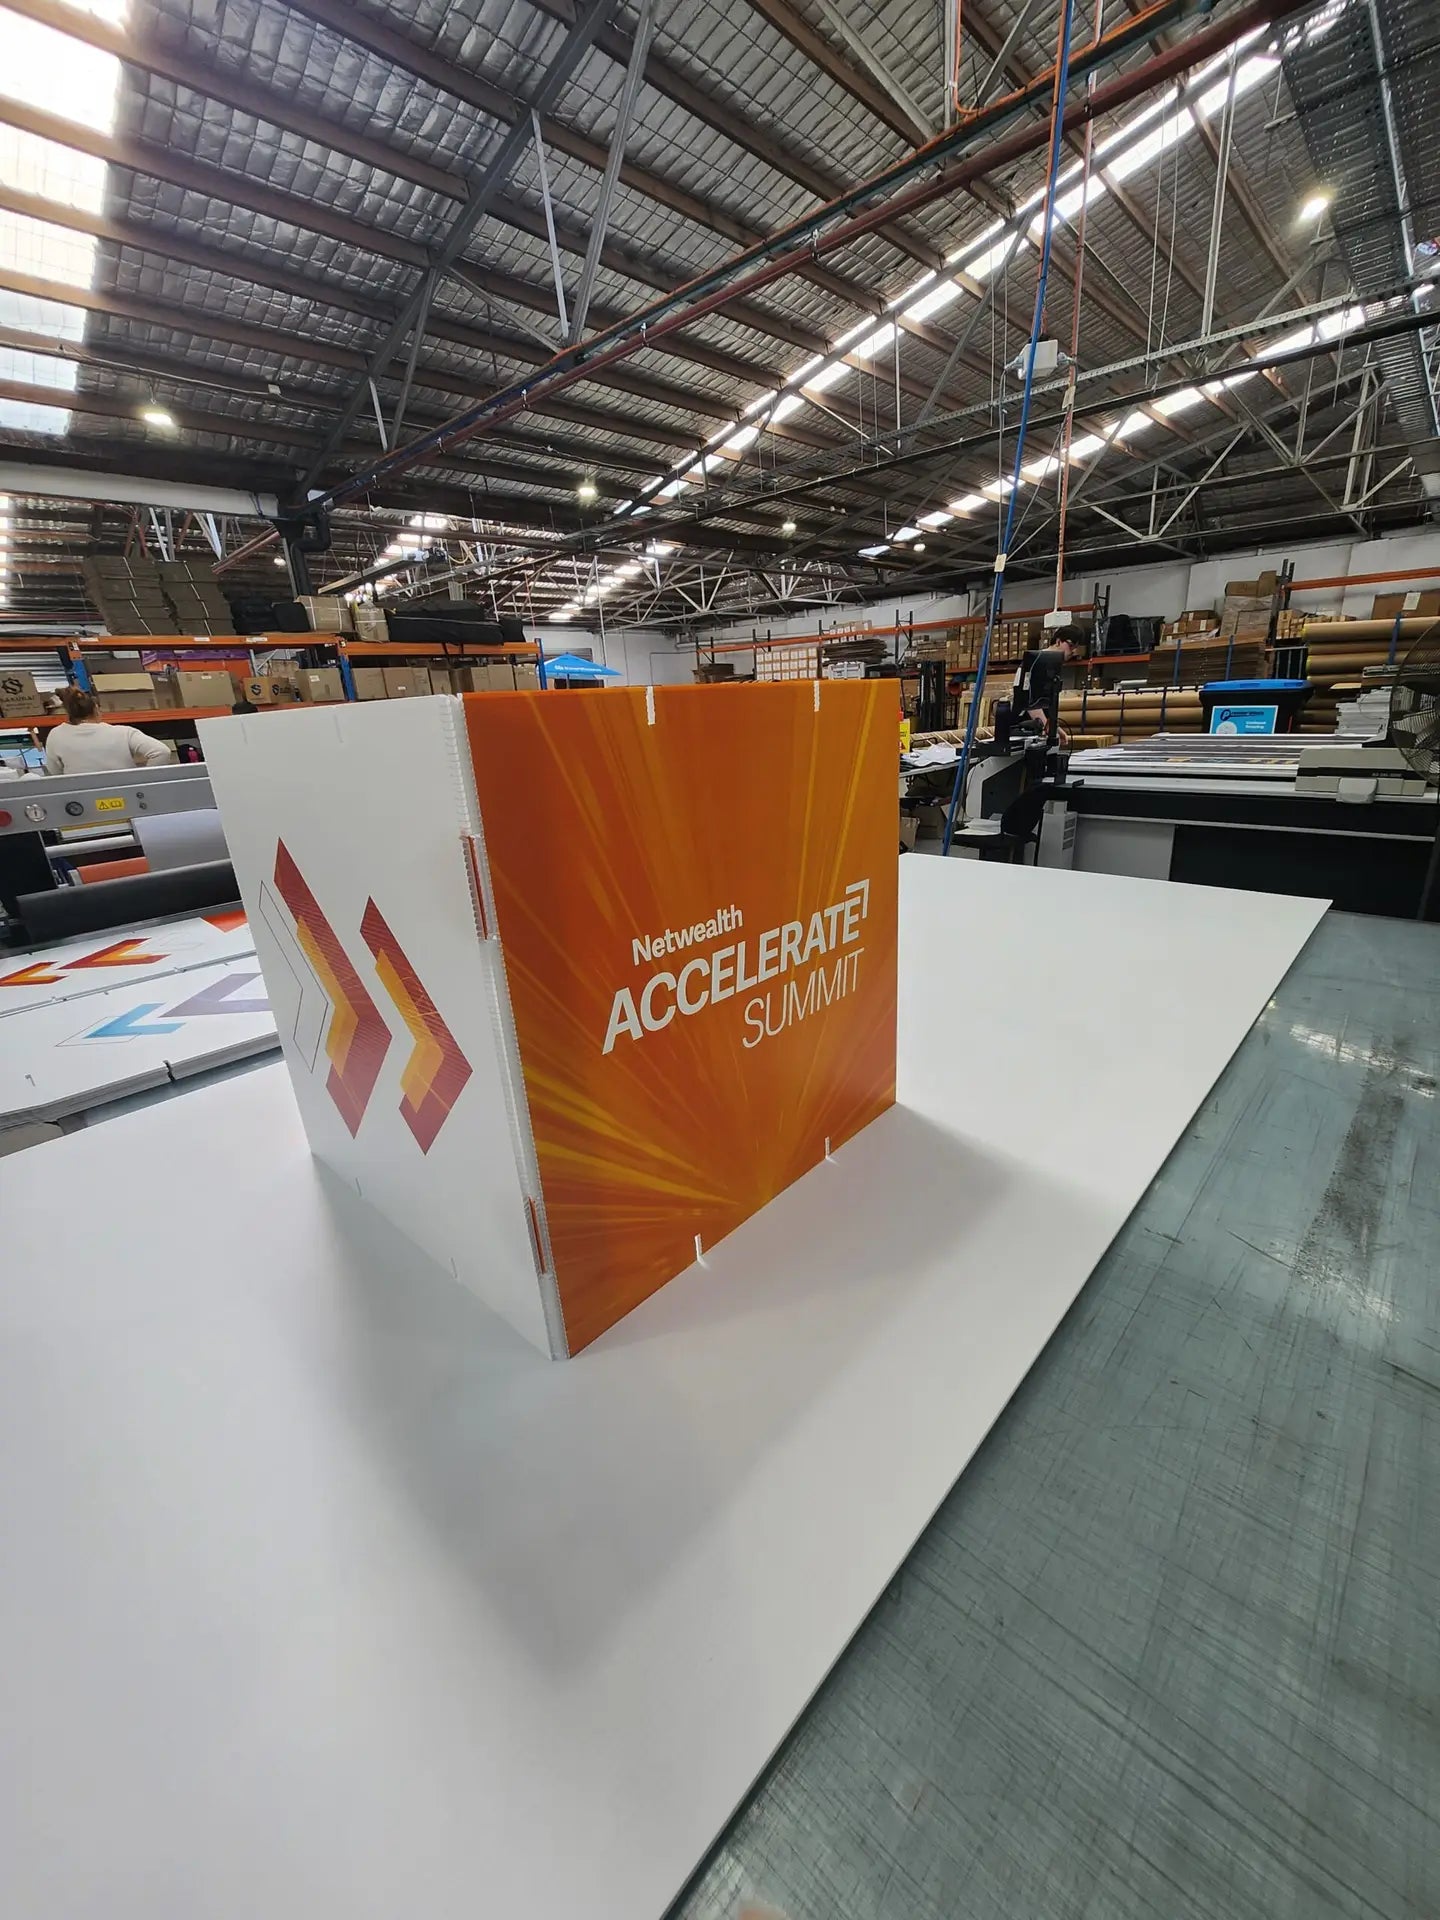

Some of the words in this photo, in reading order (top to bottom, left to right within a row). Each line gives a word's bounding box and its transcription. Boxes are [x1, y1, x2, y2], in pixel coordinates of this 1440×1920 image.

[601, 895, 861, 1055] ACCELERATE
[631, 904, 743, 966] Netwealth
[742, 947, 865, 1048] SUMMIT
